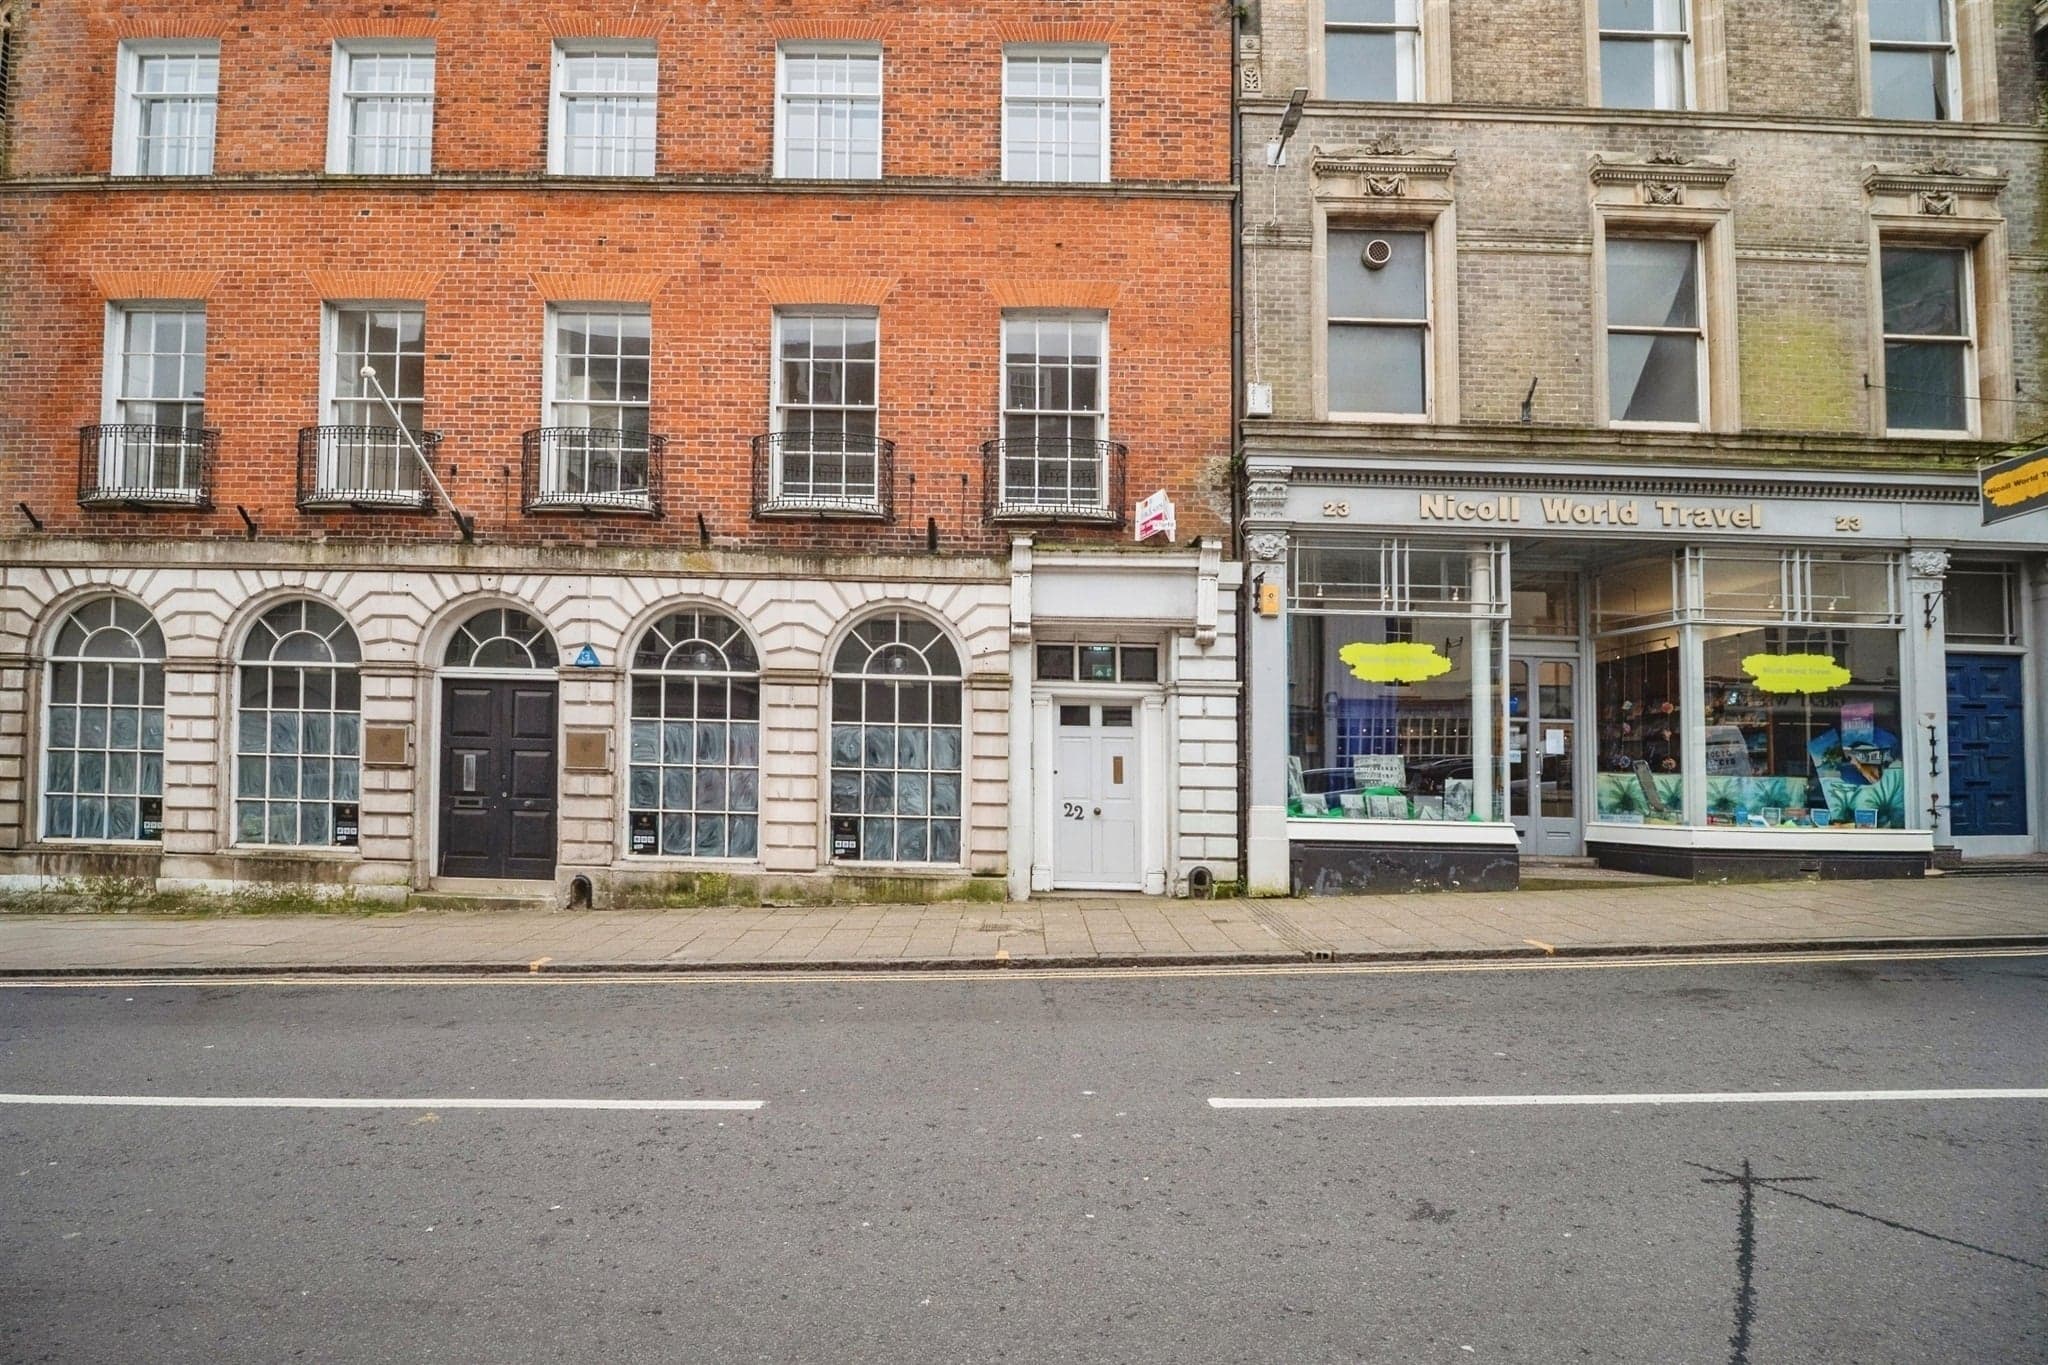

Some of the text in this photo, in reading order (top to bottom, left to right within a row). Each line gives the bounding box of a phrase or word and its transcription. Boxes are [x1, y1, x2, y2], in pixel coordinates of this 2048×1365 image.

[1323, 501, 1350, 517] 23
[1420, 494, 1762, 529] Nicoll World Travel
[1835, 515, 1863, 532] 23
[1063, 802, 1085, 820] 22
